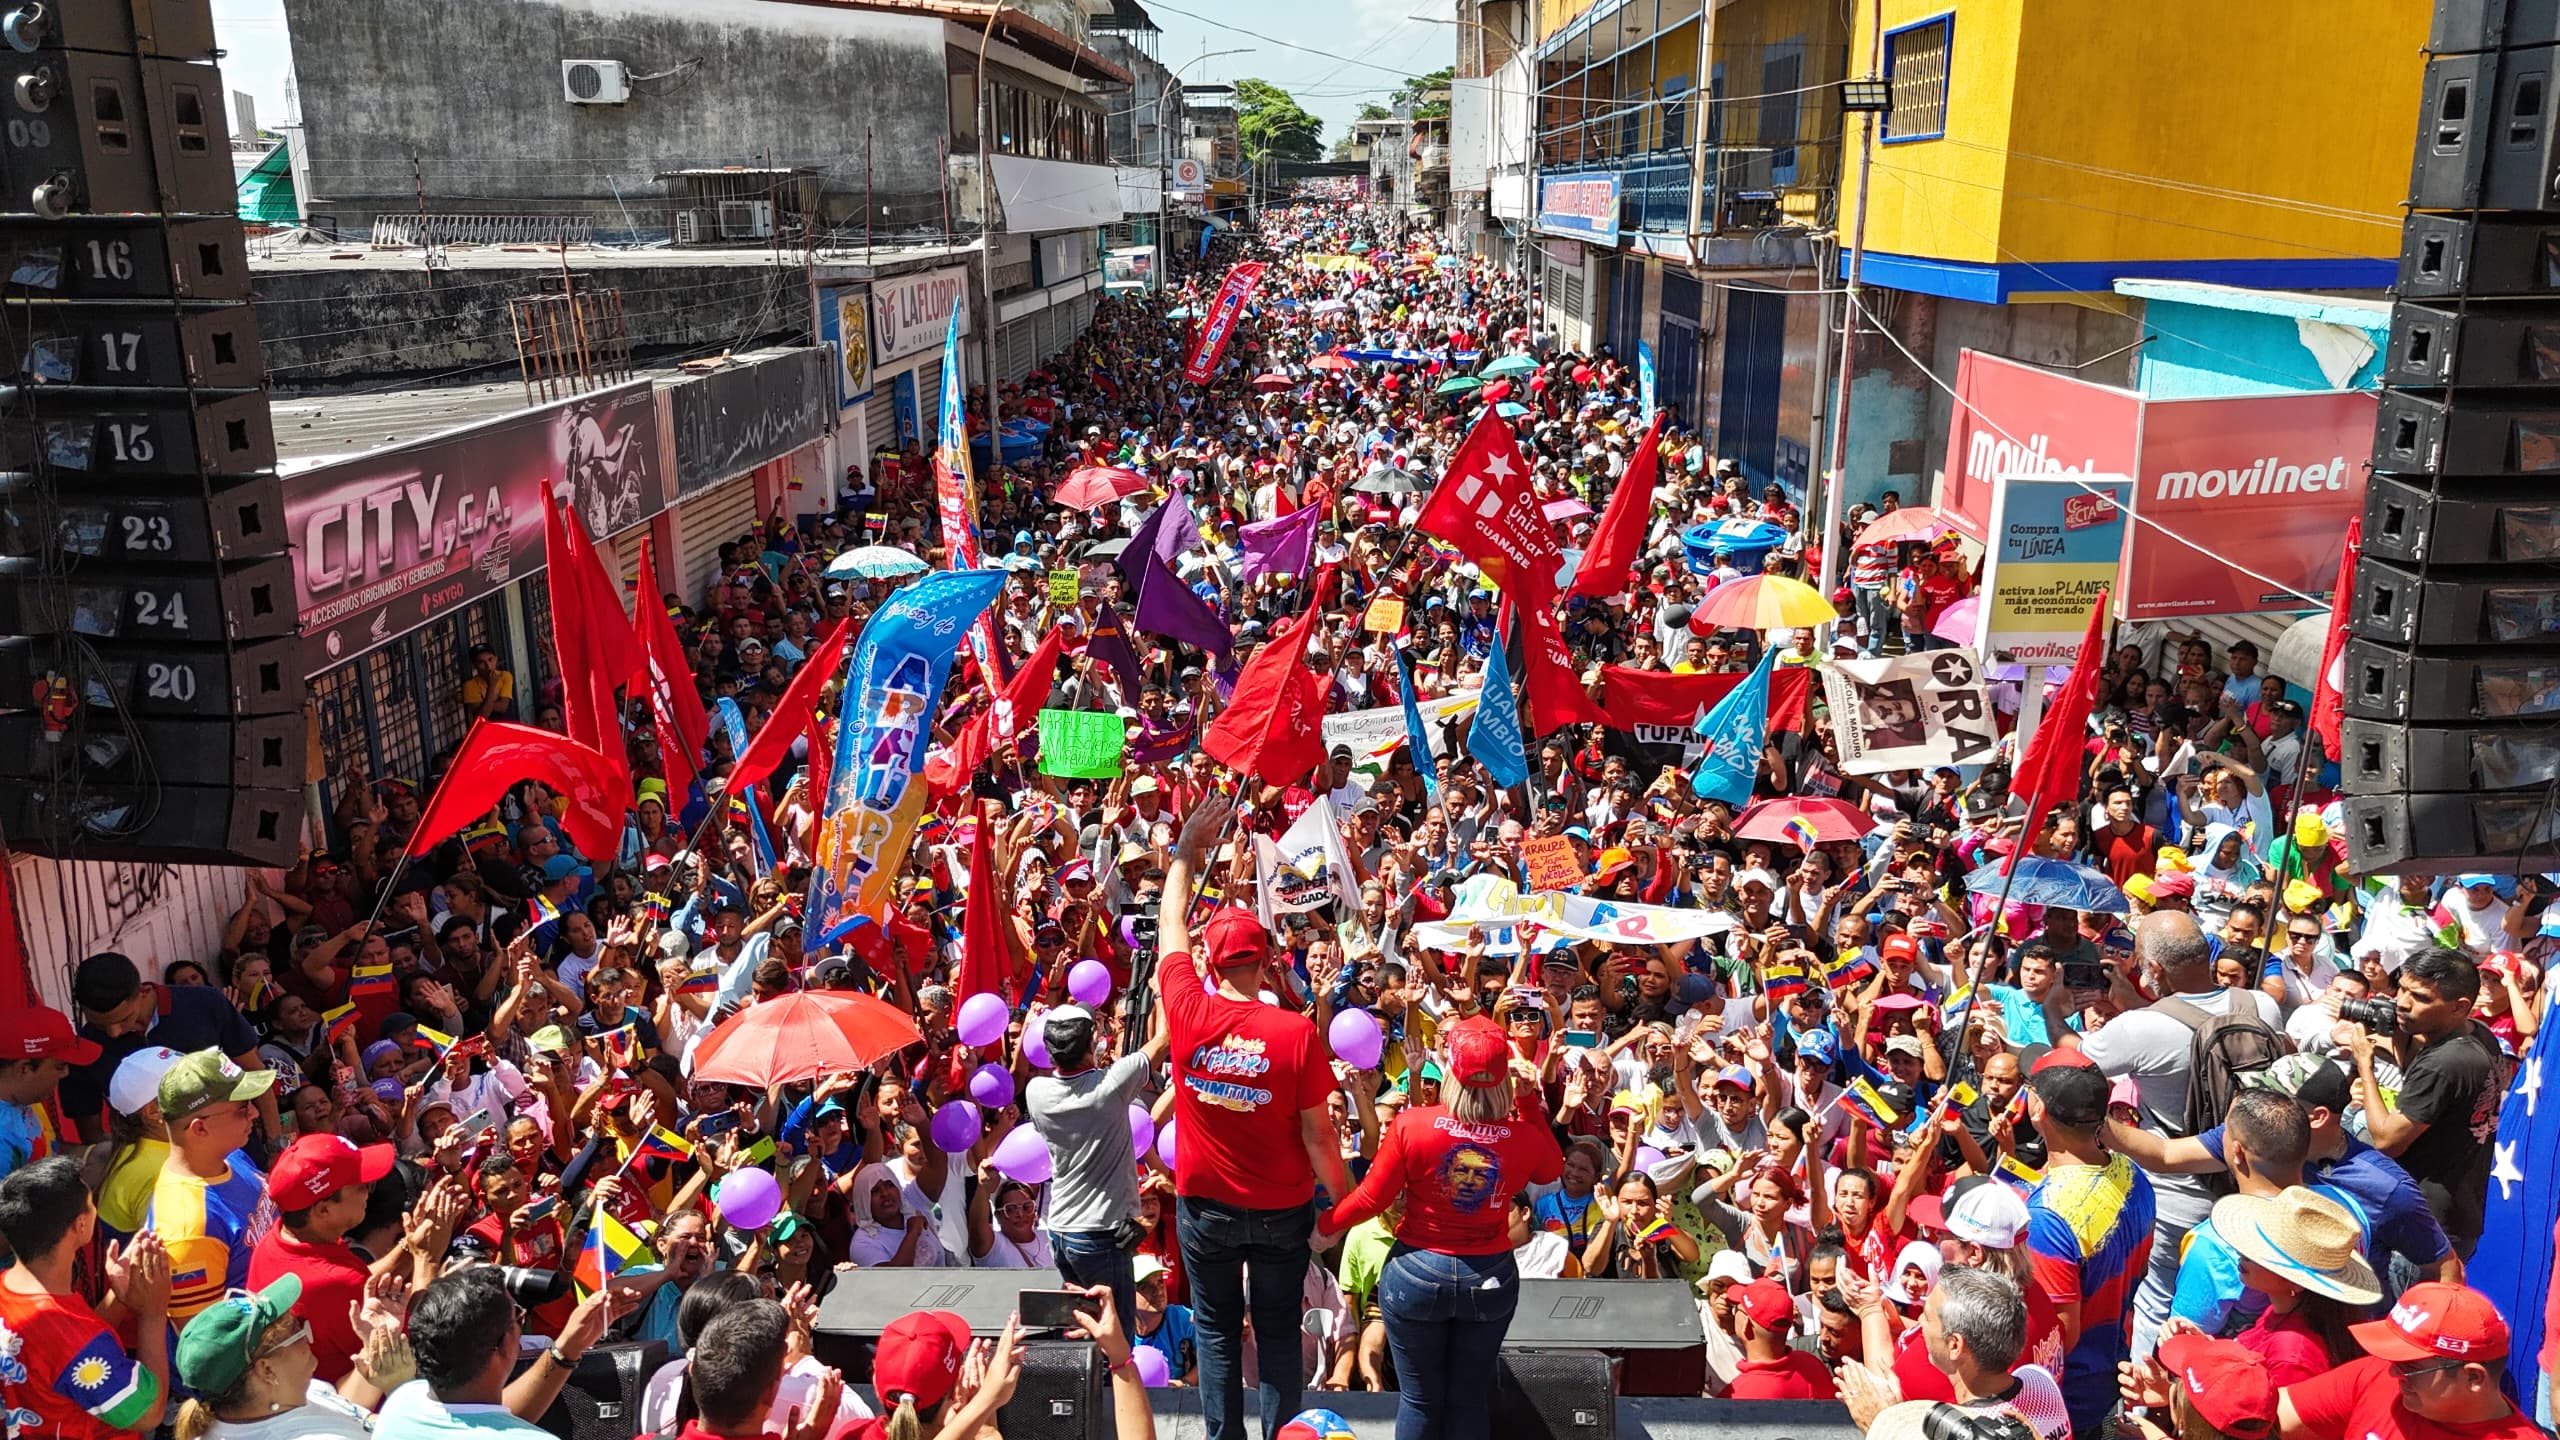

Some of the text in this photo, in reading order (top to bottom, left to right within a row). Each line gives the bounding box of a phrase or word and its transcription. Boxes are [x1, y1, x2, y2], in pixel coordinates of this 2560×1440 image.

[8, 119, 51, 148] 09
[1580, 181, 1611, 218] CENTER
[87, 239, 133, 280] 16
[101, 331, 142, 372] 17
[109, 422, 154, 462] 15
[1967, 430, 2095, 483] movil
[2156, 456, 2346, 500] movilnet
[122, 516, 172, 552] 23
[1508, 503, 1539, 534] Unir
[2010, 523, 2060, 536] Compra
[1475, 519, 1531, 570] GUANARE
[2008, 537, 2065, 559] tu LÍNEA
[311, 593, 360, 626] ACCESORIOS
[409, 558, 445, 586] GENERICOS
[432, 582, 464, 608] SKYGO
[1999, 580, 2111, 596] activa los PLANES
[2005, 596, 2029, 606] más
[135, 591, 188, 630] 24
[2013, 605, 2085, 615] del mercado
[2137, 599, 2216, 609] www.movilnet.com.ve
[907, 608, 937, 631] soy
[933, 616, 956, 637] de
[2009, 642, 2081, 659] movilne
[147, 663, 196, 701] 20
[1045, 711, 1105, 734] ARAURE
[1485, 683, 1520, 732] LIAN
[1843, 673, 1862, 759] NICOLAS MADURO
[1478, 707, 1525, 758] MBIO
[1976, 798, 1986, 810] B
[1184, 1073, 1272, 1104] PRIMITIVO
[1434, 1116, 1511, 1139] PRIMITIVO
